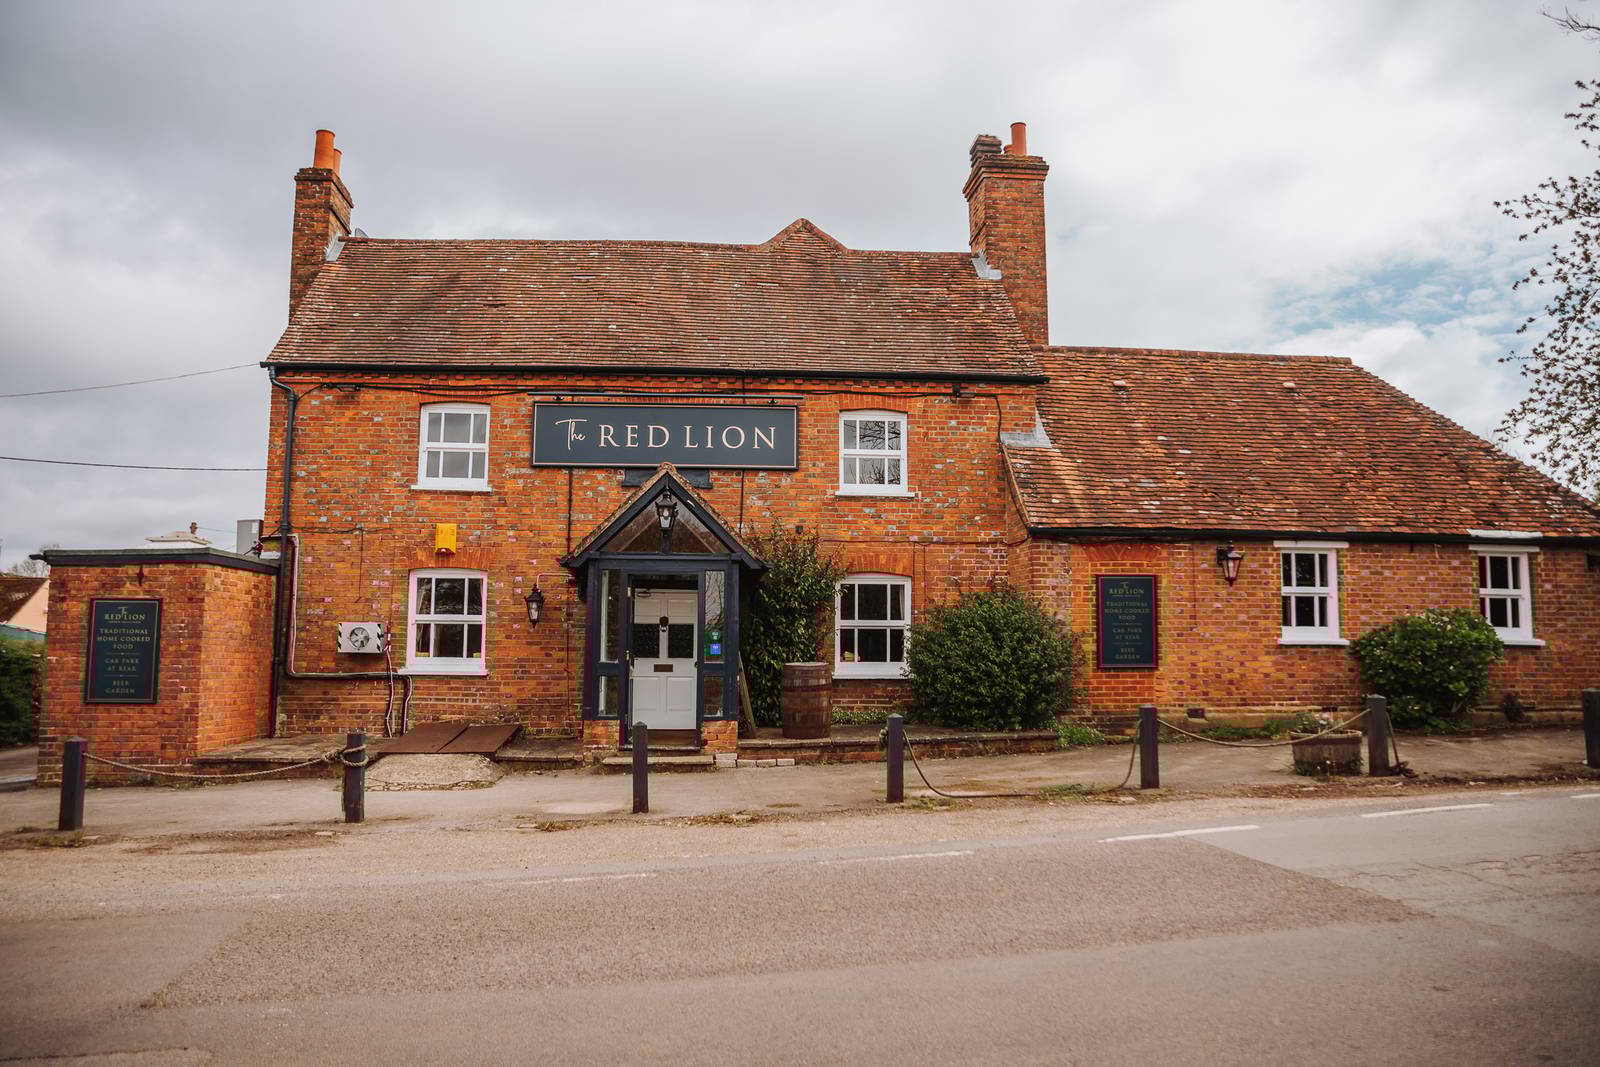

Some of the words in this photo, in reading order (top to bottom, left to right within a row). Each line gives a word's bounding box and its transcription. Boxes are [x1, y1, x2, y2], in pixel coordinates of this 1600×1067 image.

[555, 418, 587, 450] The
[599, 424, 670, 447] RED
[684, 425, 776, 449] LION
